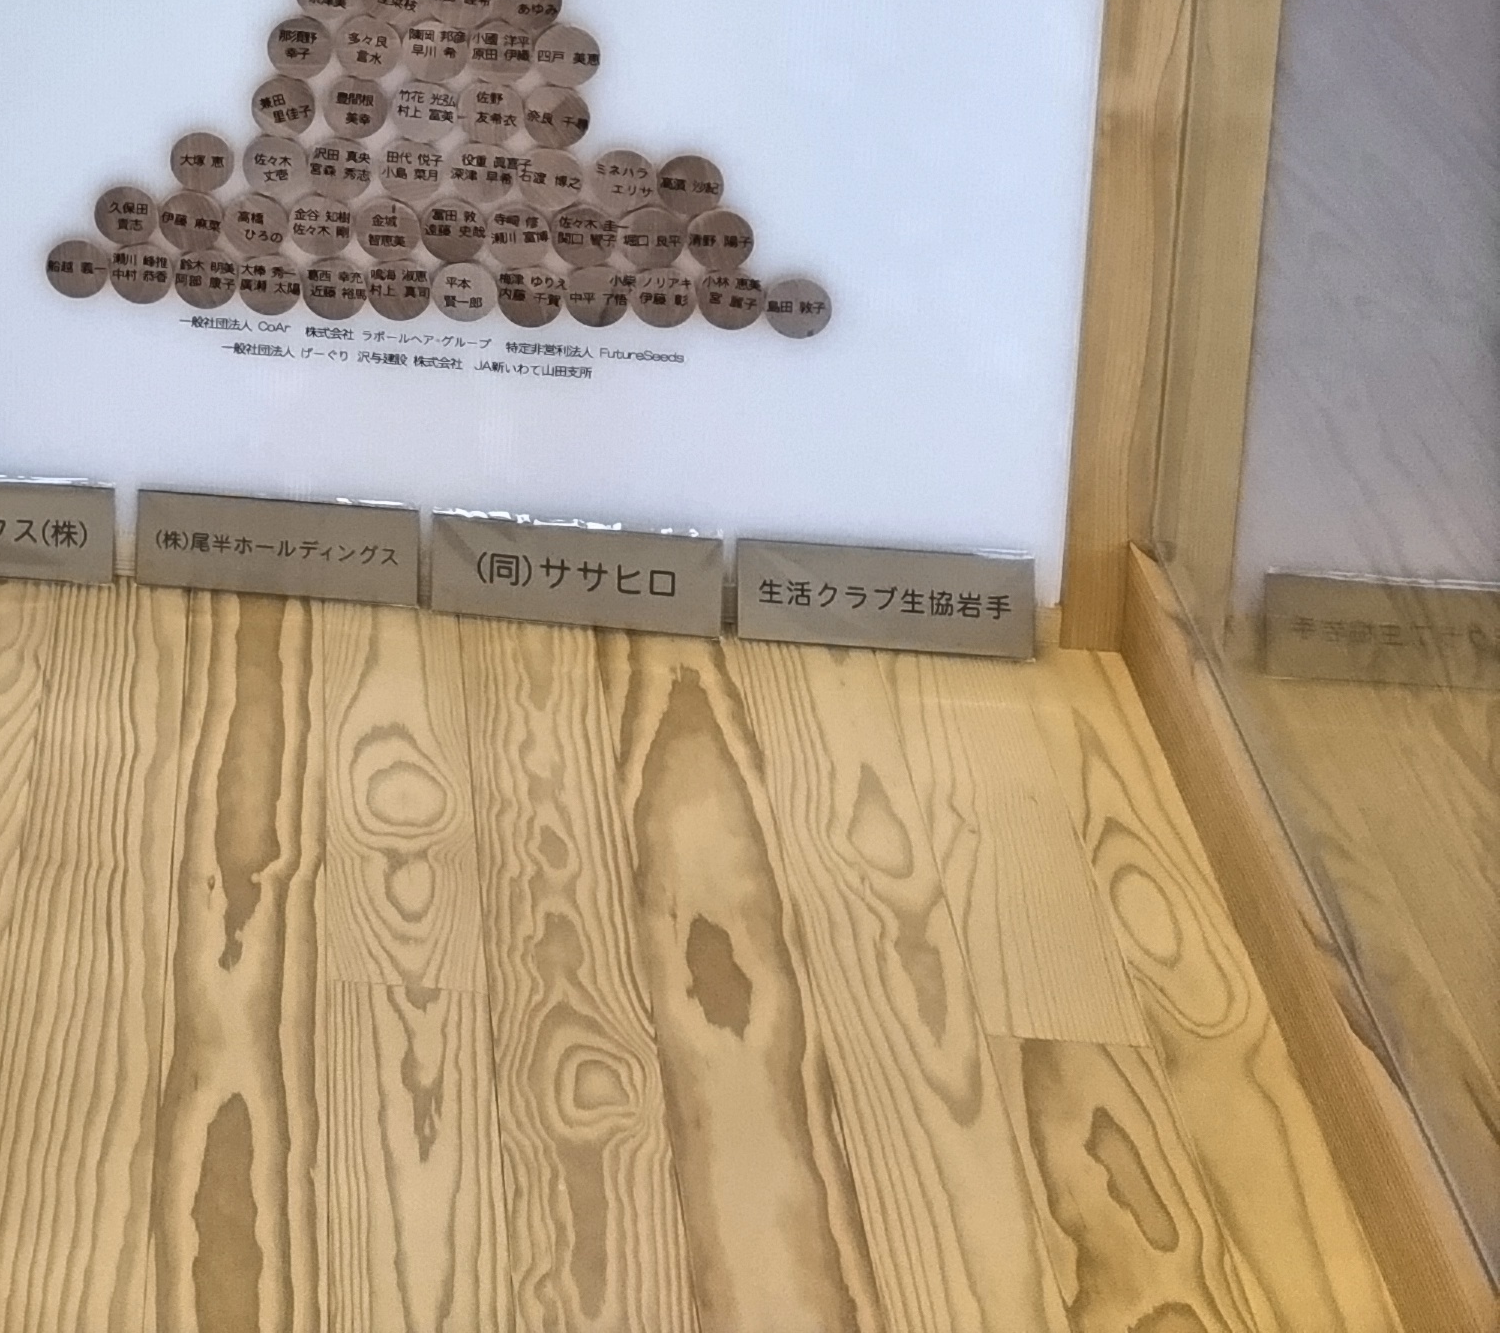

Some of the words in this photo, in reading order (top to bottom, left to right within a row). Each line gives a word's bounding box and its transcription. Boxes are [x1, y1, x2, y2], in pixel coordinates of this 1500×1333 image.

[612, 185, 653, 197] エリサ
[245, 229, 283, 243] ひろの
[446, 277, 470, 289] 平本
[444, 295, 482, 308] 賢一郎
[180, 316, 252, 331] 一般社団法人
[306, 327, 354, 340] 株式会社
[506, 342, 593, 358] 特定非営利法人
[600, 348, 684, 363] FutureSeeds
[222, 343, 294, 357] 一般社団法人
[414, 356, 462, 369] 株式会社
[475, 361, 592, 378] JA新いわて山田支所
[156, 530, 398, 565] (株)尾半ホールディングス
[477, 552, 675, 596] (同)ササヒロ
[759, 580, 1011, 620] 生活クラブ生協岩手
